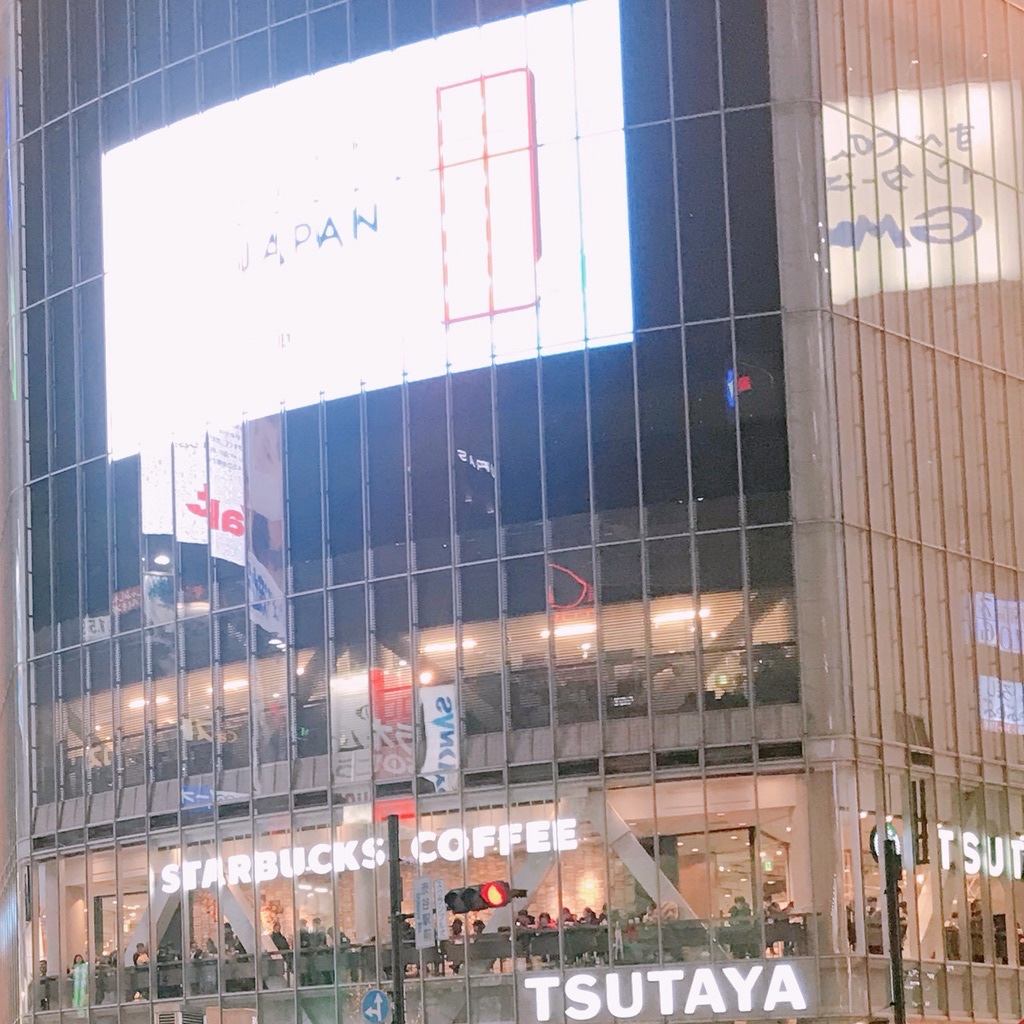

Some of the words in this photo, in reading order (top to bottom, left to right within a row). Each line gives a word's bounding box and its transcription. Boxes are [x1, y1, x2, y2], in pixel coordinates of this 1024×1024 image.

[238, 204, 378, 272] JAPAN
[161, 836, 386, 895] STARBUCKS
[410, 818, 579, 865] COFFEE
[523, 962, 809, 1023] TSUTAYA
